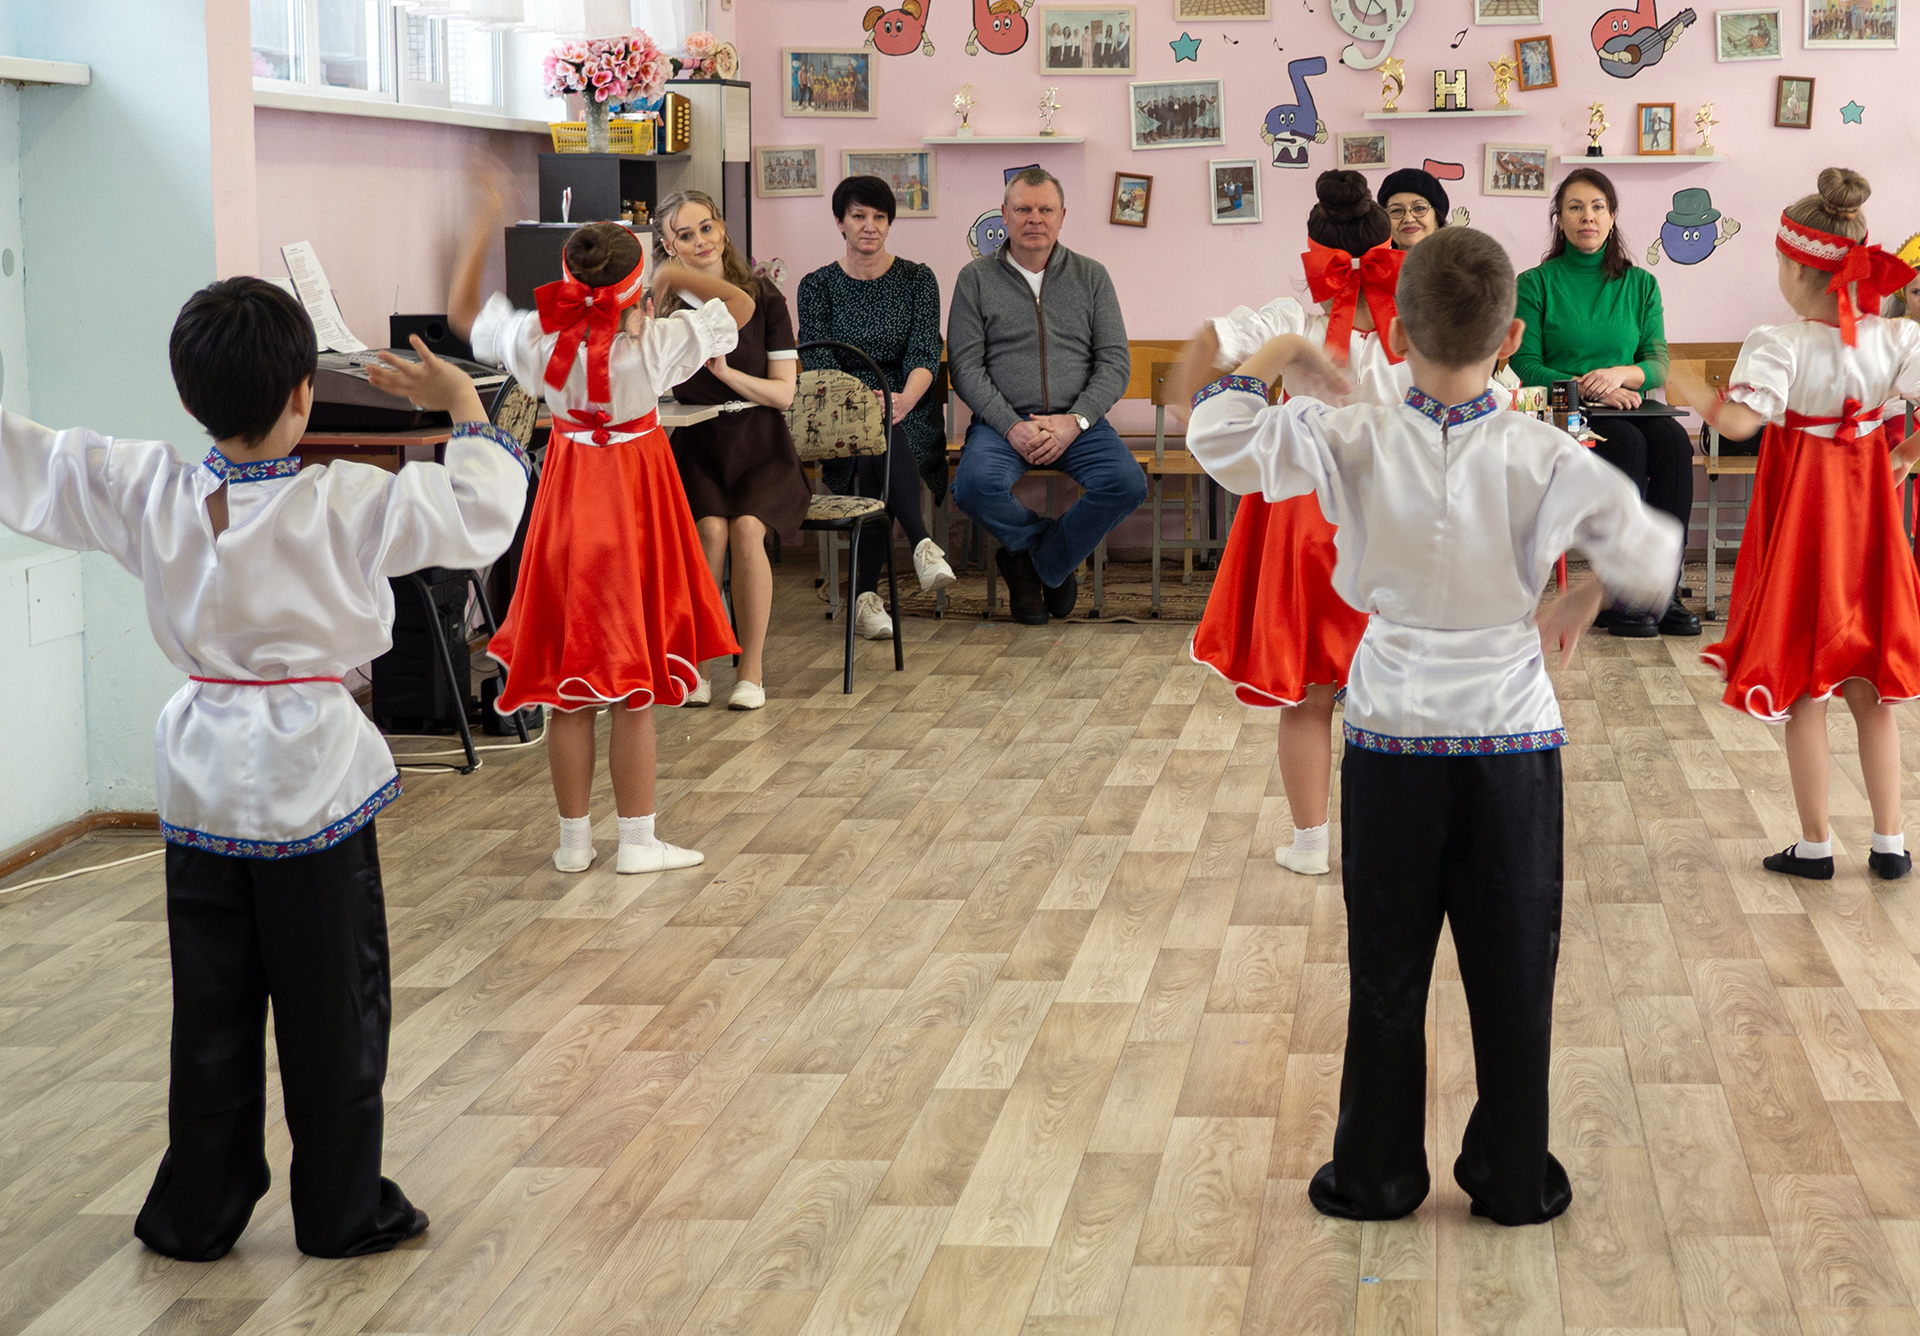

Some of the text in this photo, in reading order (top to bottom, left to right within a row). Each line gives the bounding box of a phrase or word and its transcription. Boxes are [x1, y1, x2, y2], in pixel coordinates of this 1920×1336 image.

[1339, 13, 1346, 21] 8
[1401, 10, 1407, 18] 4
[1352, 25, 1358, 34] 7
[1387, 24, 1394, 32] 5
[1369, 31, 1376, 39] 6
